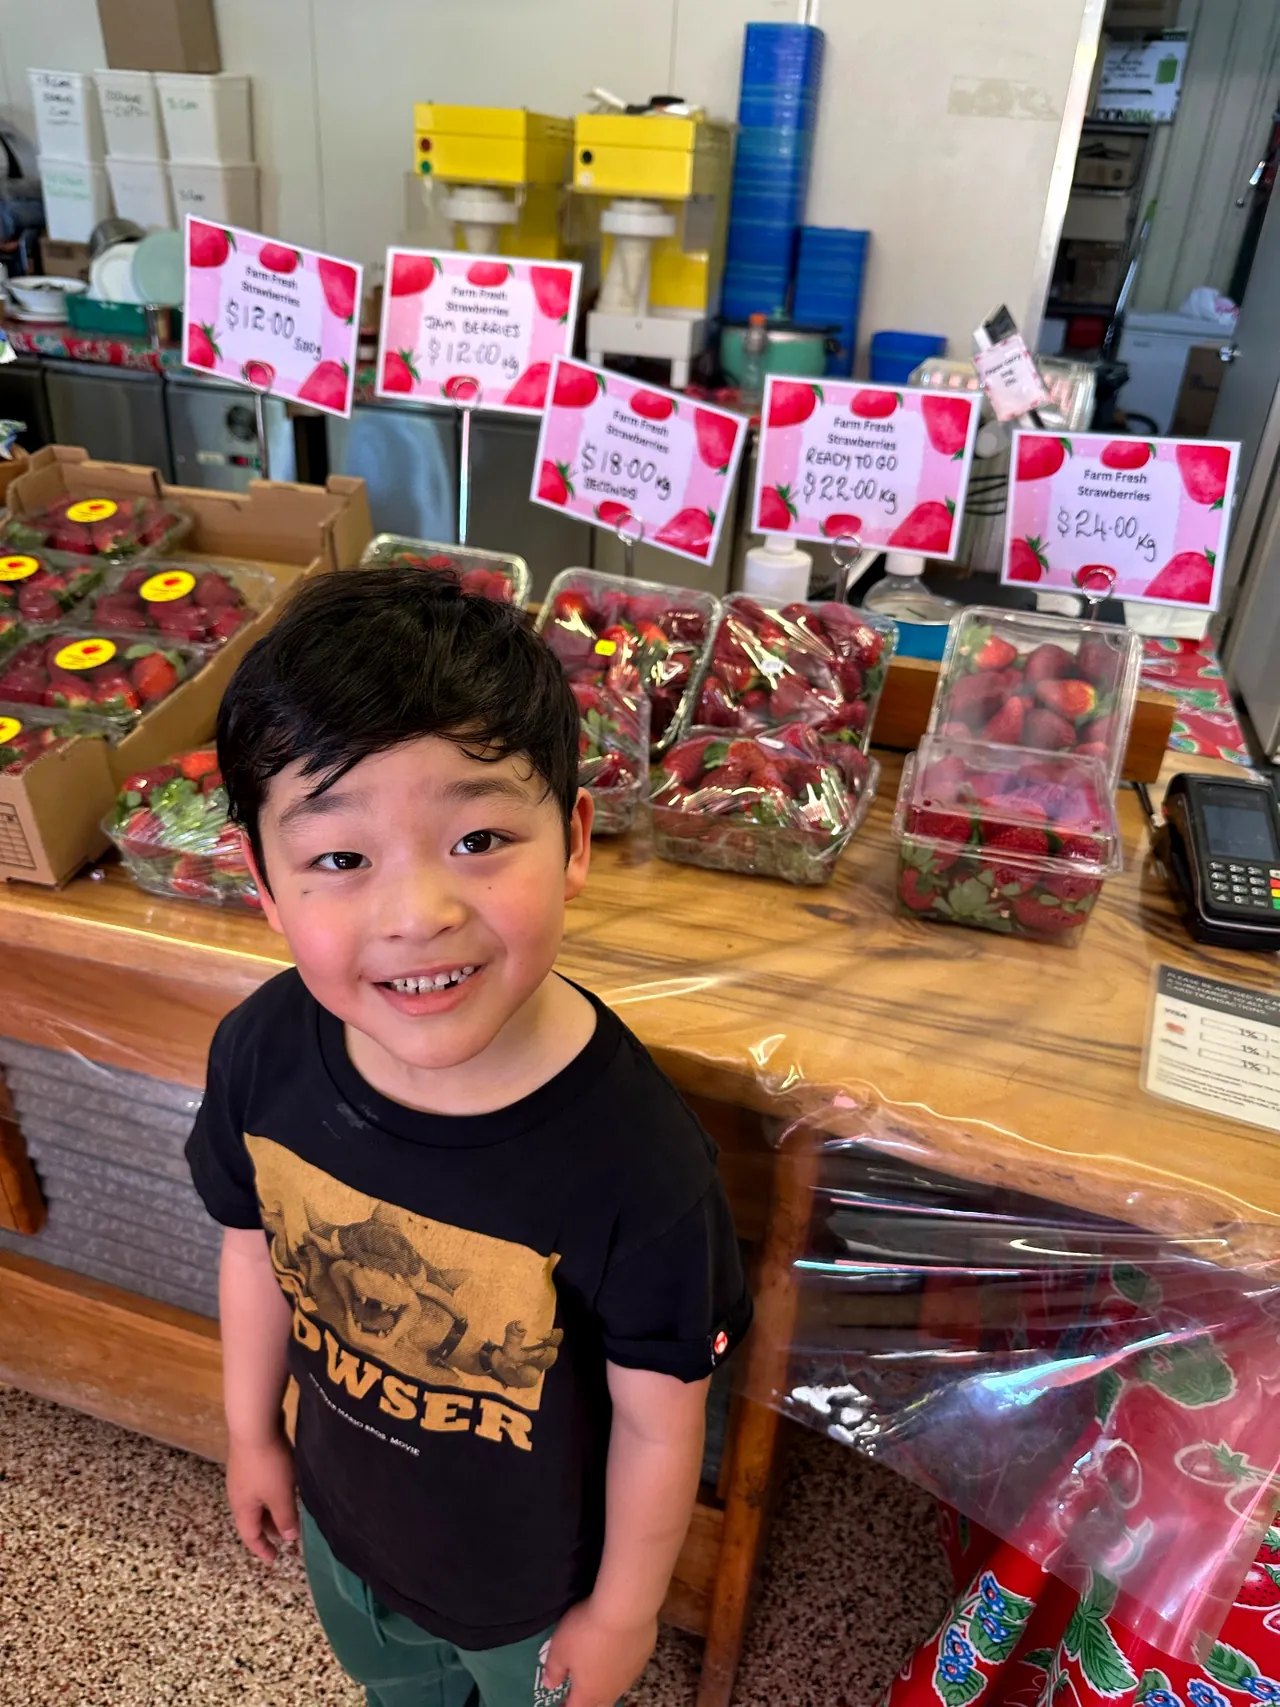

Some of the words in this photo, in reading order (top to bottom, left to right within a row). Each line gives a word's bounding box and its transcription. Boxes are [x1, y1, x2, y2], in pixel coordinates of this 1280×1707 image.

[246, 267, 268, 281] Farm
[272, 276, 297, 288] Fresh
[242, 281, 300, 307] Strawberries
[452, 286, 475, 297] Farm
[480, 290, 507, 300] Fresh
[446, 302, 508, 316] Strawberries
[424, 316, 455, 331] JAM
[463, 321, 520, 338] BERRIES
[613, 410, 639, 428] Farm
[641, 420, 669, 436] Fresh
[834, 417, 861, 430] Farm
[864, 420, 894, 433] Fresh
[606, 424, 669, 454] Strawberries
[828, 434, 896, 450] Strawberries
[806, 448, 850, 469] READY
[855, 456, 873, 469] TO
[876, 456, 897, 471] GO
[1083, 470, 1112, 481] Farm
[1114, 472, 1147, 483] Fresh
[584, 477, 638, 500] SECONDS
[1077, 487, 1150, 502] Strawberries
[1166, 983, 1193, 995] CARD
[1168, 972, 1199, 985] PLEASE
[1215, 986, 1253, 1000] ADVISED
[1175, 981, 1229, 999] SURCHARGE
[1164, 1008, 1187, 1018] VISA
[1239, 1028, 1258, 1039] 1%
[1241, 1044, 1260, 1056] 1%
[1242, 1060, 1261, 1071] 1%
[291, 1305, 533, 1452] OWSER
[390, 1437, 420, 1456] MOVIE
